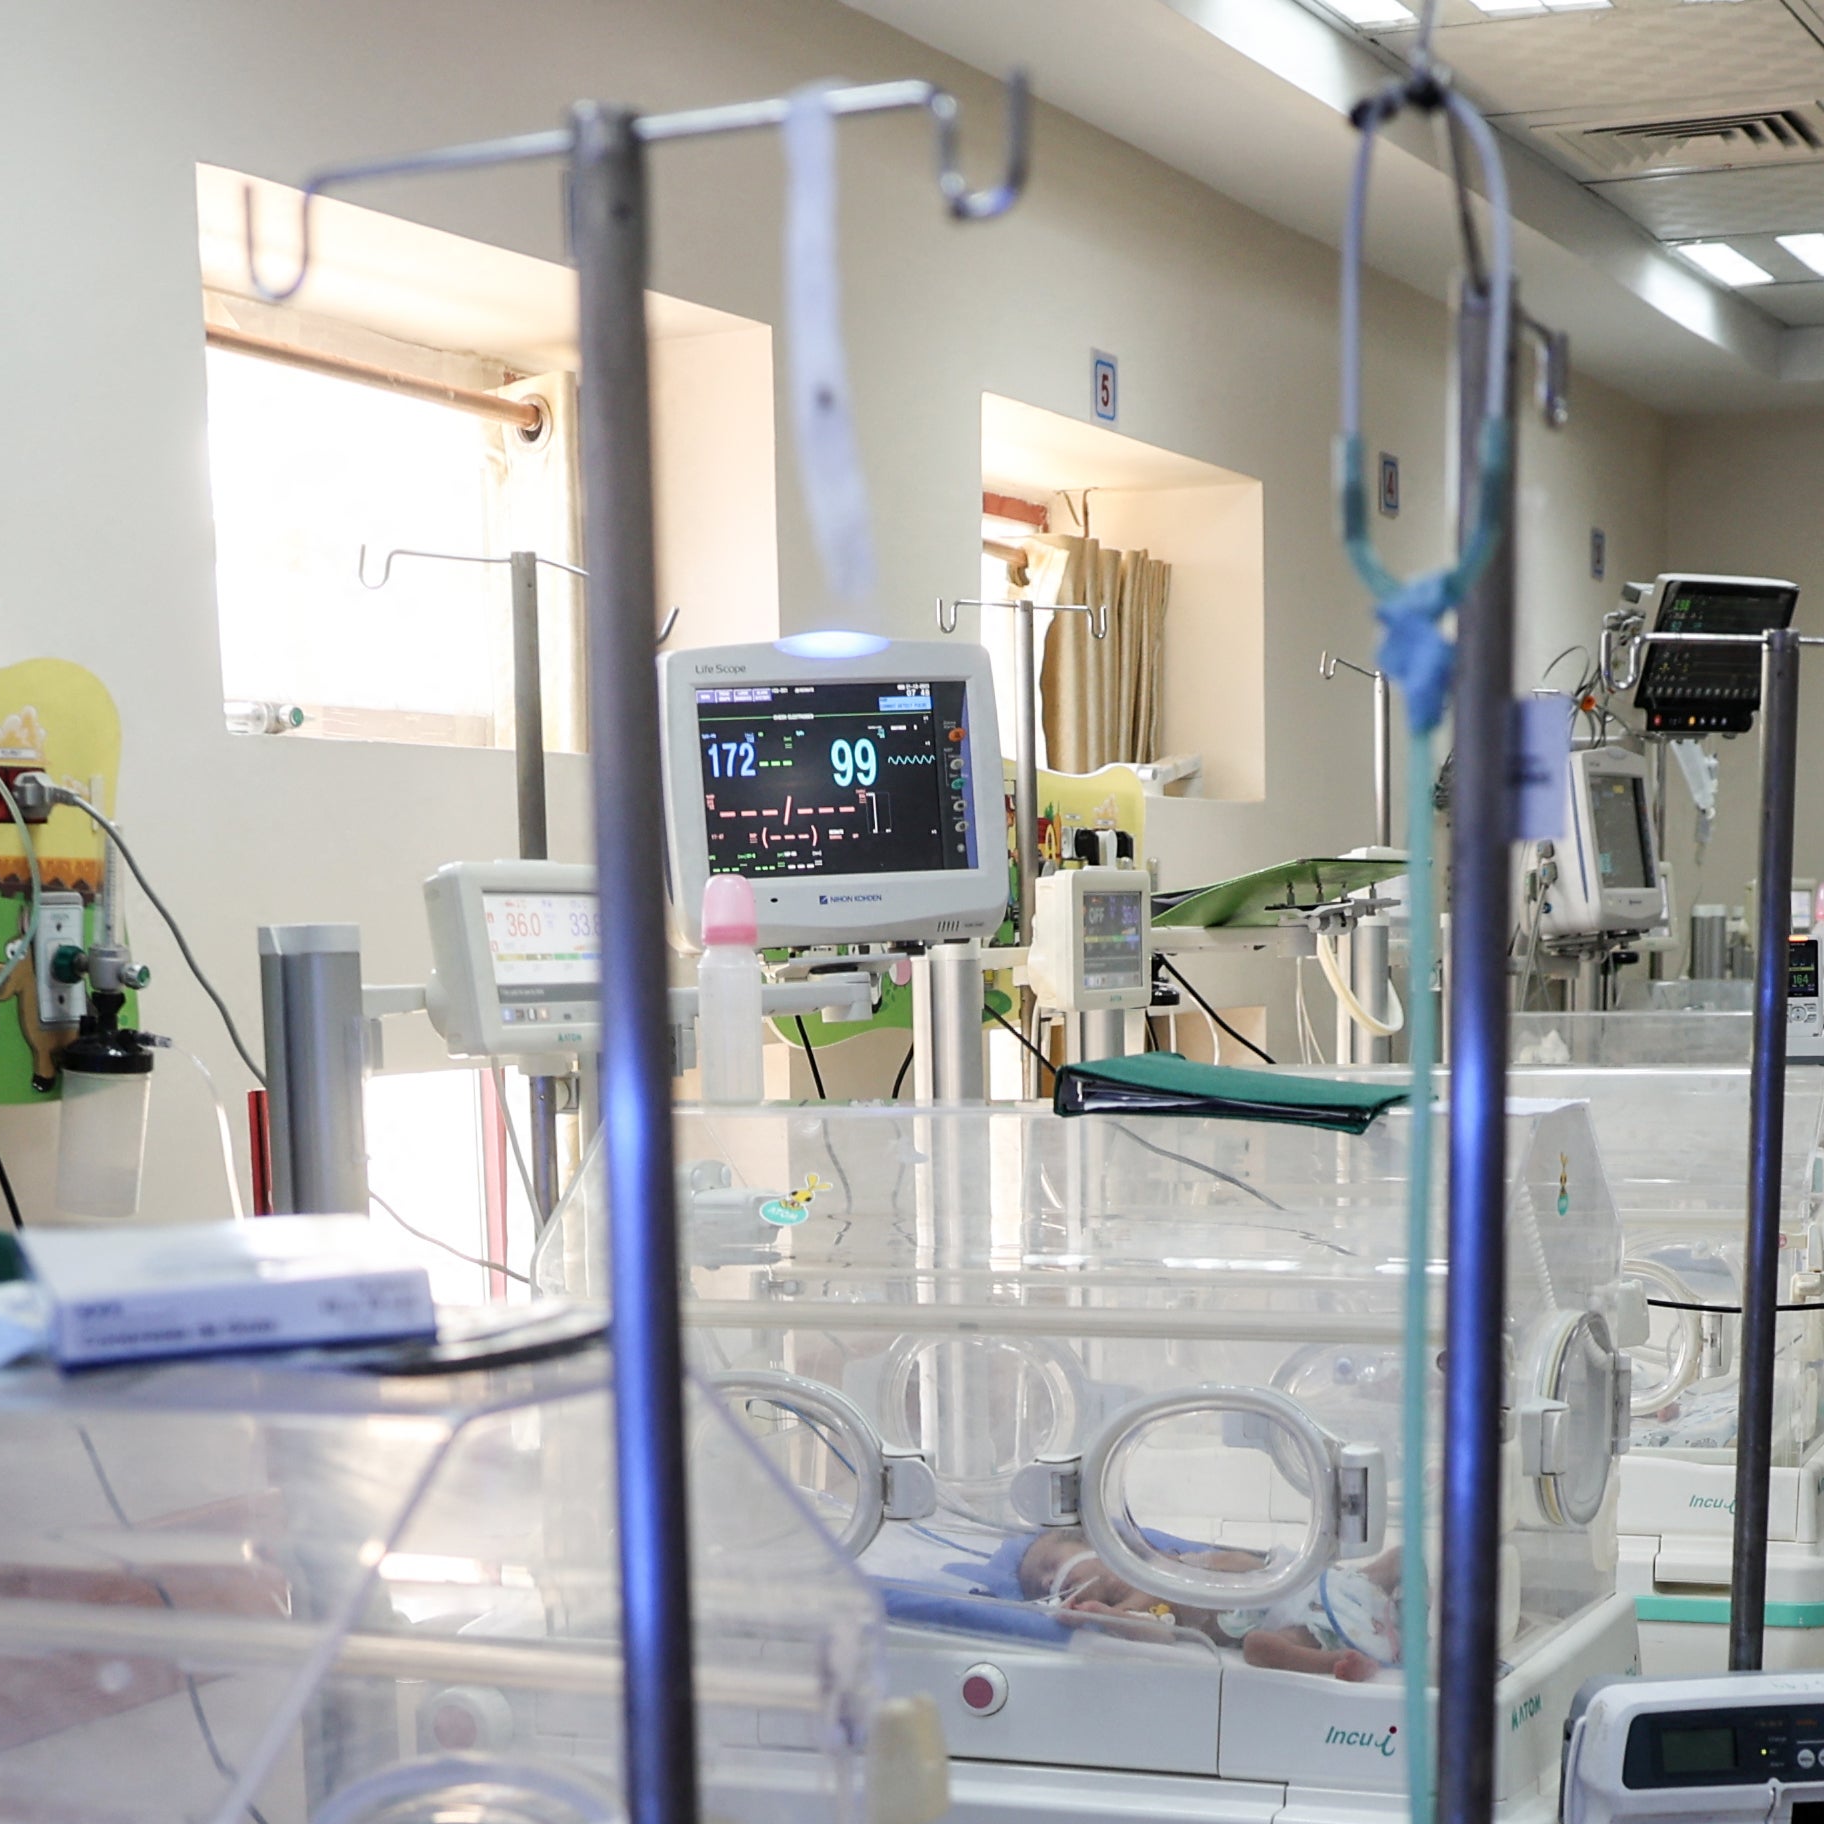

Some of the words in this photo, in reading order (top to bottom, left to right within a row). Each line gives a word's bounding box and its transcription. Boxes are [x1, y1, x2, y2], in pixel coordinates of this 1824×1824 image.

[1100, 372, 1110, 408] 5
[695, 664, 714, 674] Life
[715, 664, 747, 676] Scope
[707, 742, 757, 779] 172
[830, 737, 878, 788] 99
[830, 895, 853, 903] NIHON
[853, 894, 882, 903] KOHDEN
[506, 912, 542, 937] 36.0
[1793, 973, 1810, 985] 164
[1689, 1494, 1724, 1510] Incu
